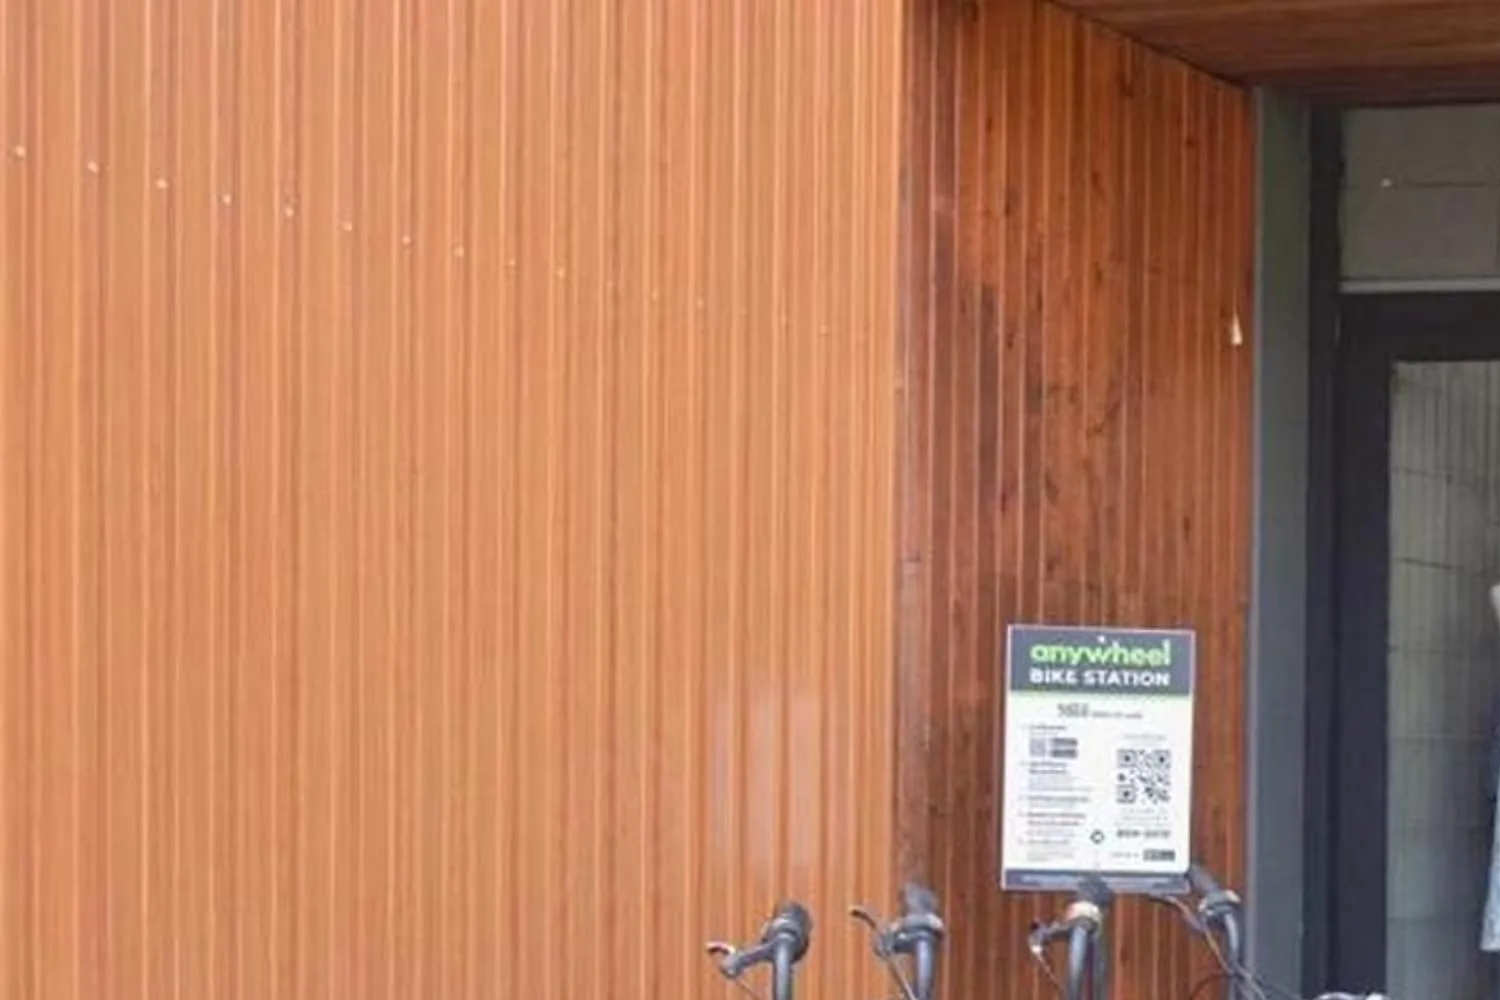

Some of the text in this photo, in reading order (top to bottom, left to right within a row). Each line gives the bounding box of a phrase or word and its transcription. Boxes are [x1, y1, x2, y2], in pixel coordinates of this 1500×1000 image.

[1030, 639, 1172, 667] anywheel
[1030, 668, 1170, 687] BIKE STATION
